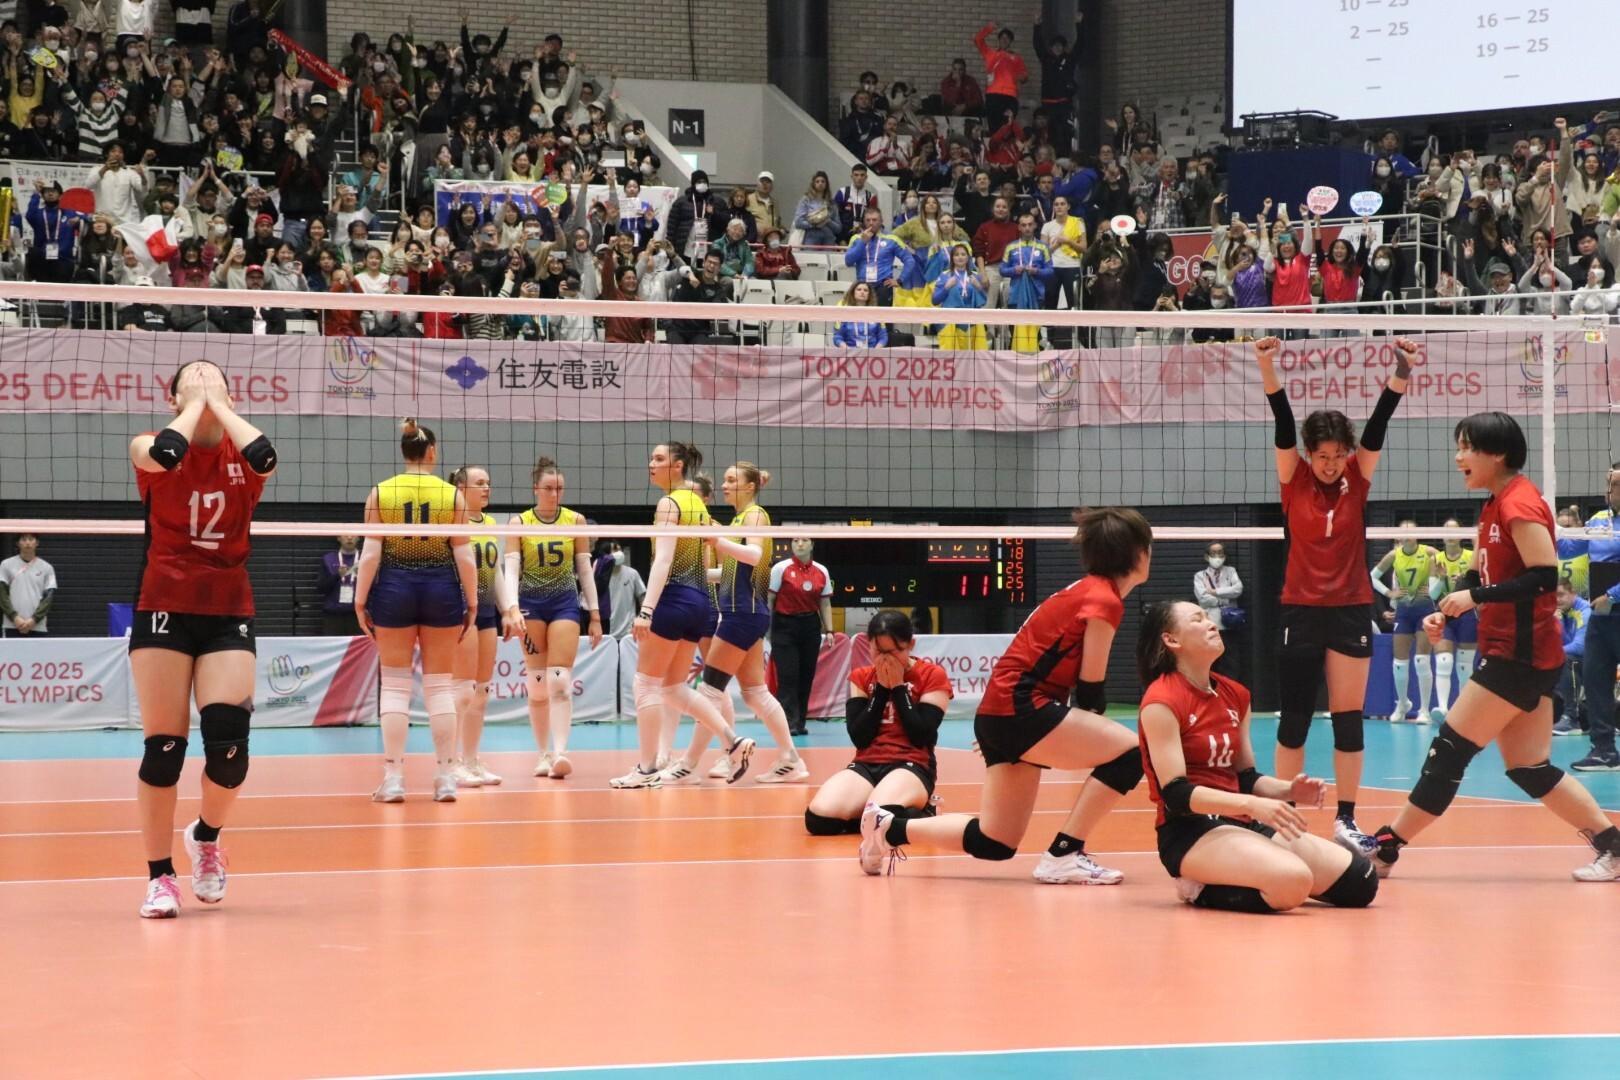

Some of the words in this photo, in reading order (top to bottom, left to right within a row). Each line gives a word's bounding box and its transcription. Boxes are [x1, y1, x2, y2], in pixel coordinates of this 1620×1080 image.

[1350, 26, 1360, 39] 2
[1388, 22, 1409, 36] 25
[1477, 14, 1498, 28] 16
[1527, 9, 1549, 24] 25
[1477, 43, 1498, 57] 19
[1527, 38, 1549, 53] 25
[673, 120, 699, 134] N-1
[801, 356, 887, 379] TOKYO
[896, 357, 956, 381] 2025
[1280, 347, 1352, 371] OKYO
[1363, 344, 1428, 368] 205
[497, 357, 622, 390] 住友電設
[43, 373, 289, 402] DEAFLYICS
[826, 384, 1004, 411] DEAFLYMPICS
[187, 490, 226, 539] 12
[403, 501, 430, 541] 11
[1325, 509, 1334, 538] 1
[474, 541, 498, 569] 10
[536, 541, 564, 568] 15
[1005, 562, 1024, 574] 25
[1406, 567, 1417, 587] 7
[961, 575, 989, 597] 11
[1005, 576, 1024, 589] 25
[151, 611, 169, 634] 12
[31, 662, 84, 680] 2025
